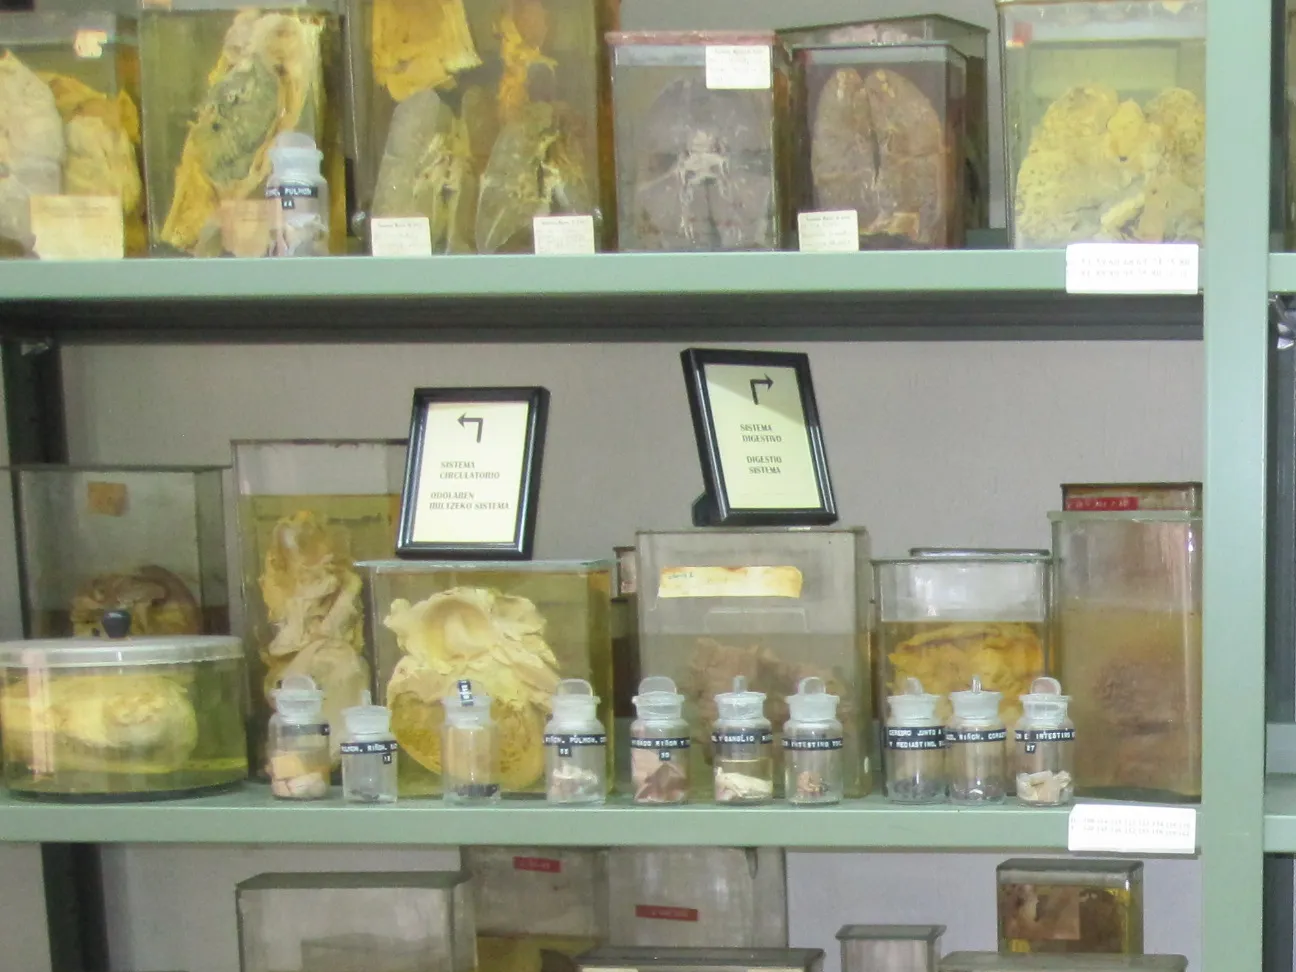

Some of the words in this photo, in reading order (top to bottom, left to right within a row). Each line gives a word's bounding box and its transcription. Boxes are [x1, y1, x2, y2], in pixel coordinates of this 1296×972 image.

[740, 424, 772, 432] SISTEMA
[742, 434, 782, 443] DIGESTIVO
[746, 455, 782, 463] DIGESTIO
[441, 461, 475, 469] SISTEMA
[749, 466, 781, 474] SISTEMA
[440, 471, 500, 480] CIRCULATORIO
[474, 502, 509, 511] SISTEMA
